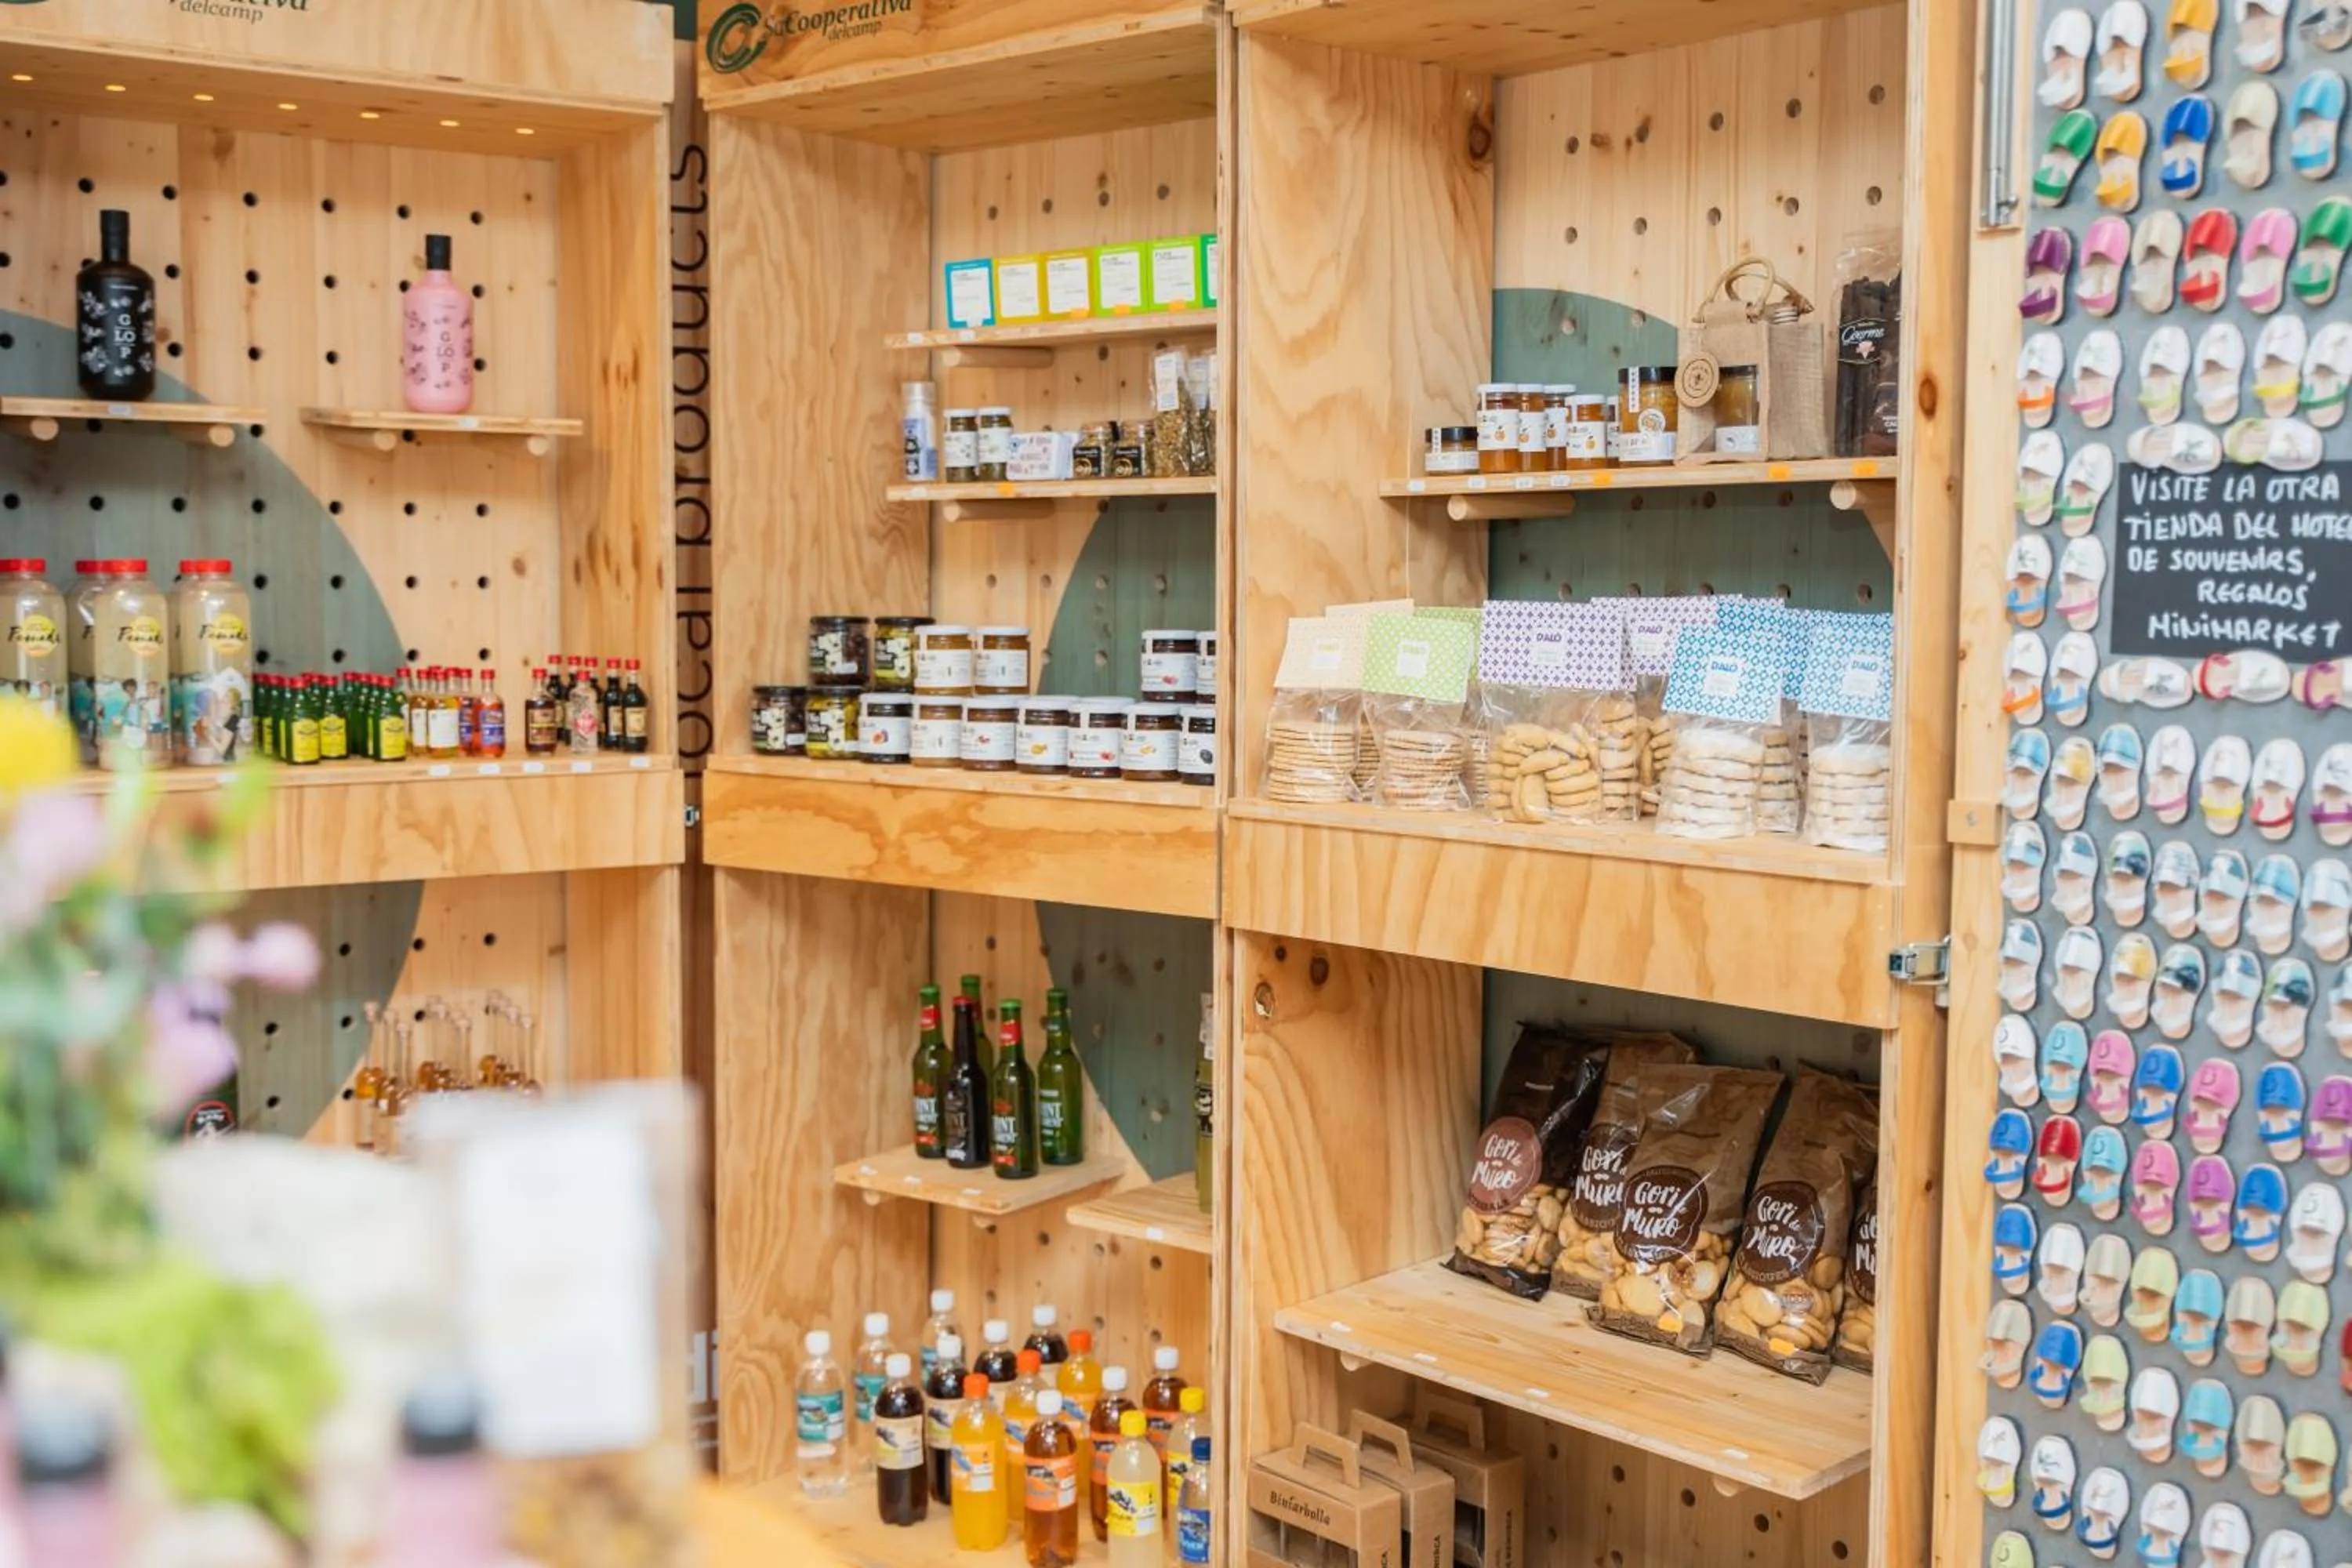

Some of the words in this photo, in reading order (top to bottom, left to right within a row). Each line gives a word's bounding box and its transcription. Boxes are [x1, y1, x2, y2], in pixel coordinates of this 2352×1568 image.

[2223, 474, 2256, 502] LA
[2266, 472, 2340, 503] OTRA
[2234, 512, 2280, 540] DEL
[2128, 546, 2159, 572] DE
[2197, 579, 2309, 611] REGALOS
